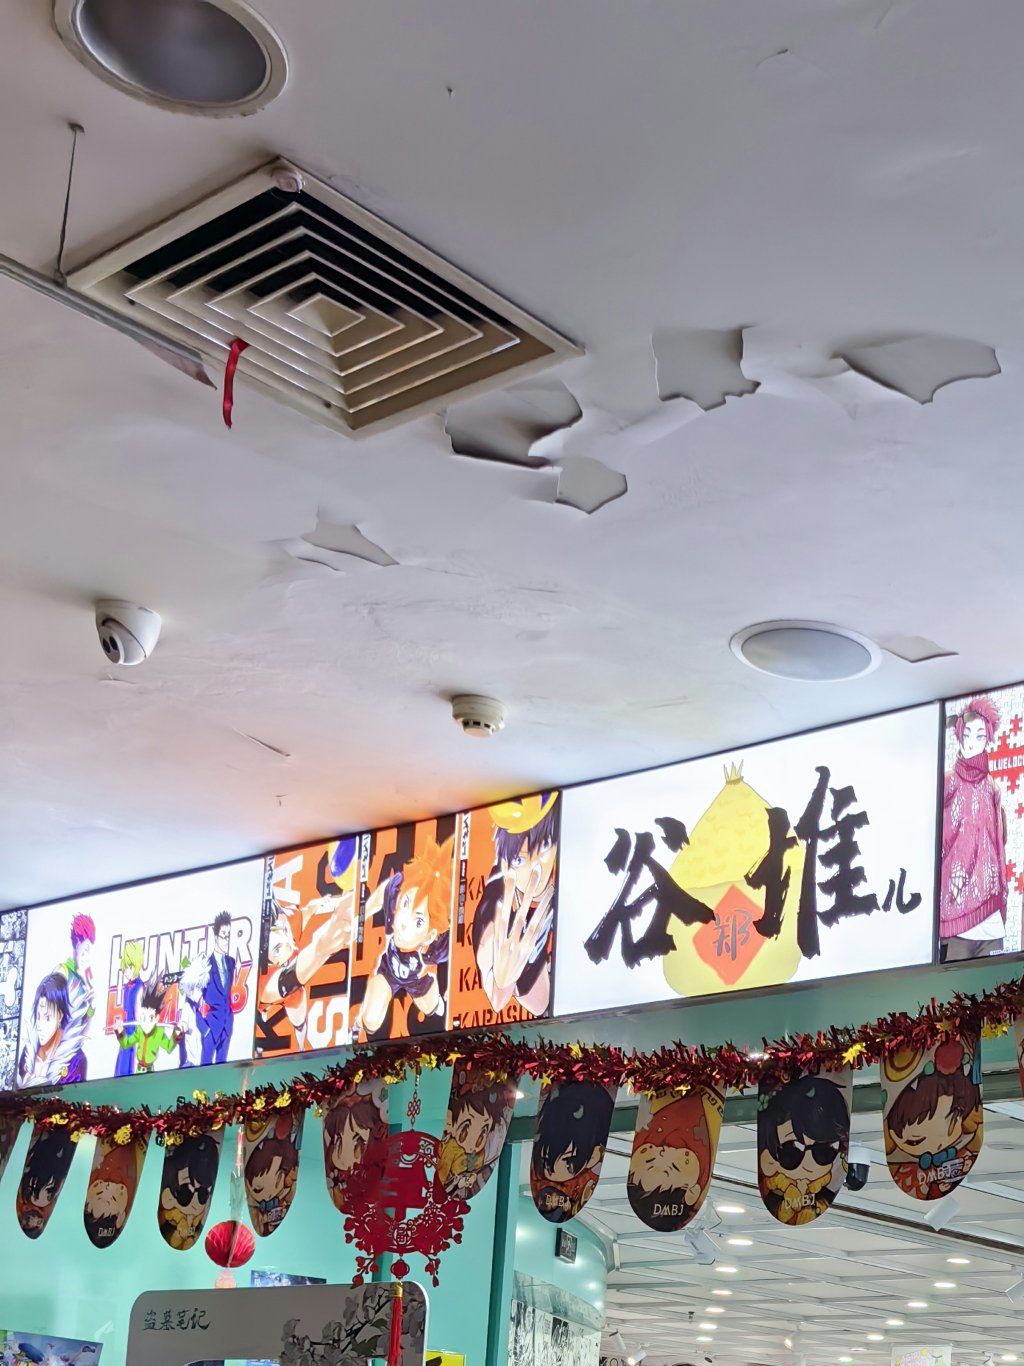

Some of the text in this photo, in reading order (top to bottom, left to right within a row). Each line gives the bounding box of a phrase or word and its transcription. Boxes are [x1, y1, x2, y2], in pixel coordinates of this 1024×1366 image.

[109, 916, 253, 990] HUNTR
[918, 1164, 951, 1185] DMBJ
[653, 1203, 683, 1217] DMBJ
[784, 1193, 816, 1209] DMBJ
